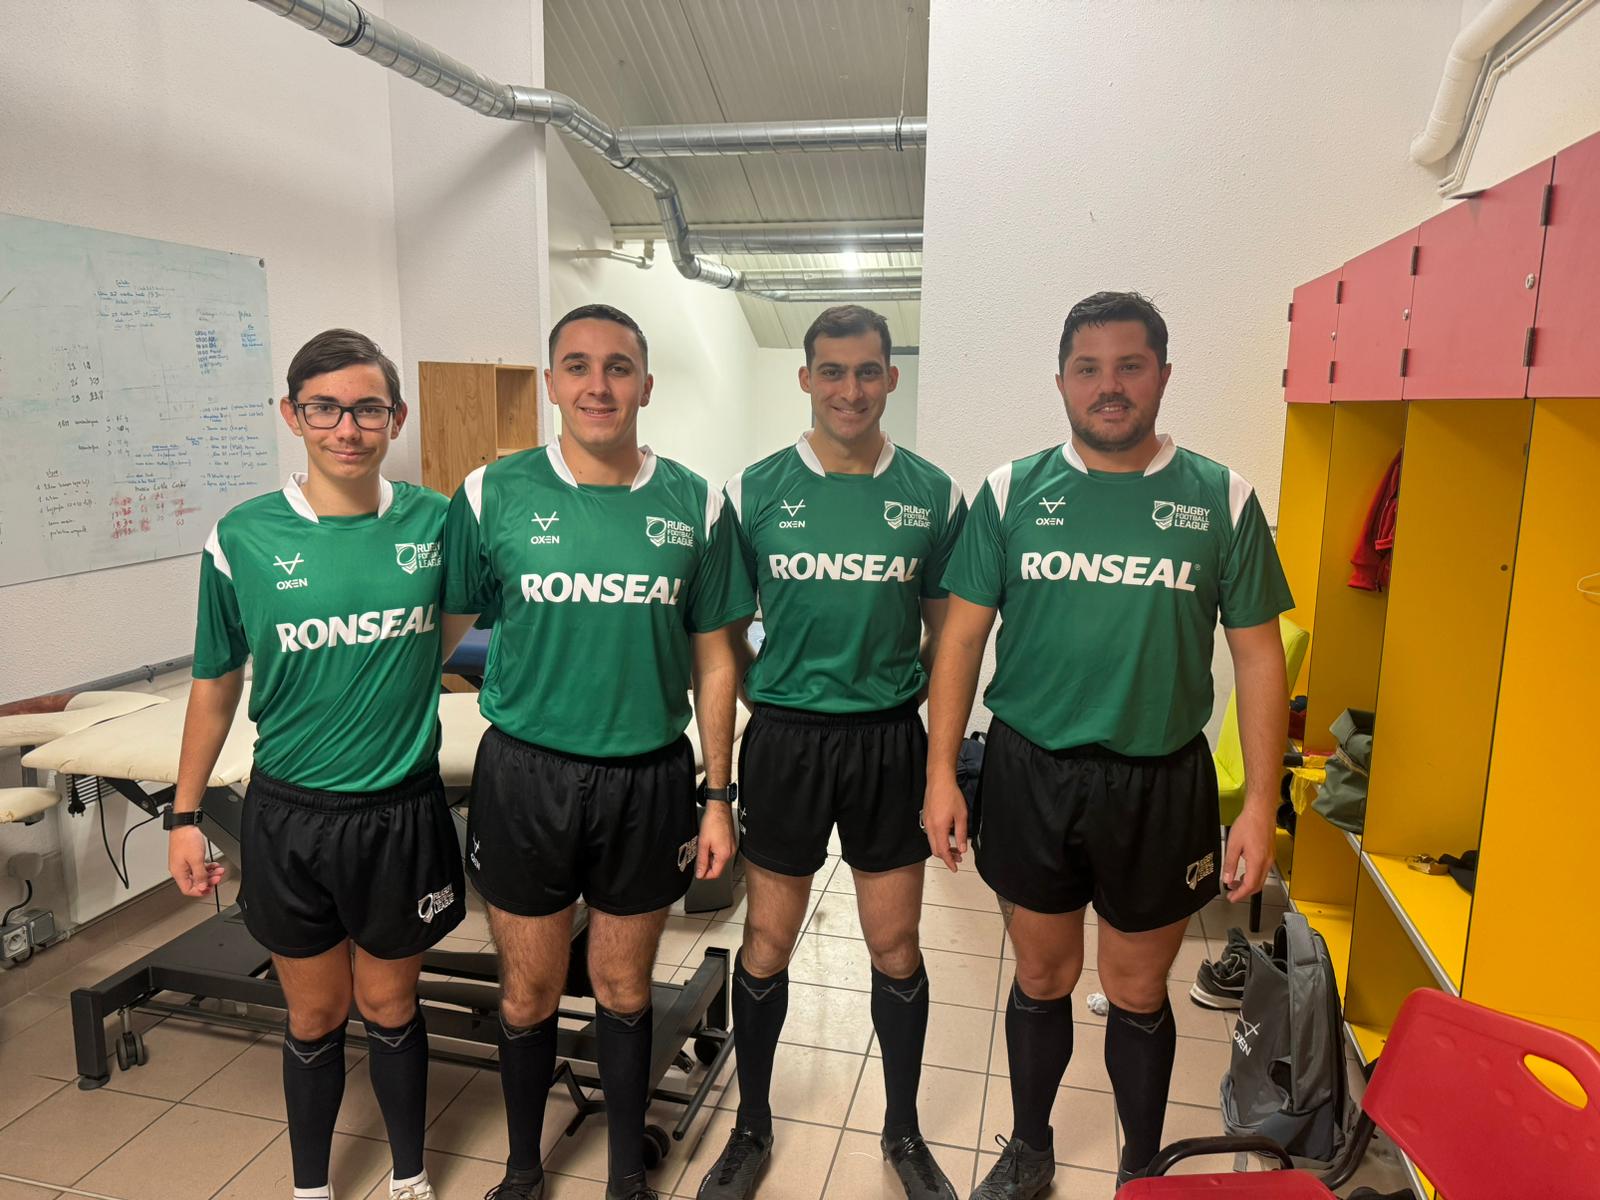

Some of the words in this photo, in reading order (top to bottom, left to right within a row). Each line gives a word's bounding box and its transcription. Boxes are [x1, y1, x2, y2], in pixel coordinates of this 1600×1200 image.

[1176, 504, 1211, 517] RUGBY
[779, 520, 806, 529] OXEN
[1035, 517, 1065, 526] OXEN
[1174, 518, 1210, 531] LEAGUE
[530, 535, 560, 545] OXEN
[768, 552, 919, 583] RONSEAL
[1020, 551, 1197, 592] RONSEAL
[276, 577, 309, 591] OXEN
[520, 571, 682, 606] RONSEAL
[275, 603, 436, 653] RONSEAL
